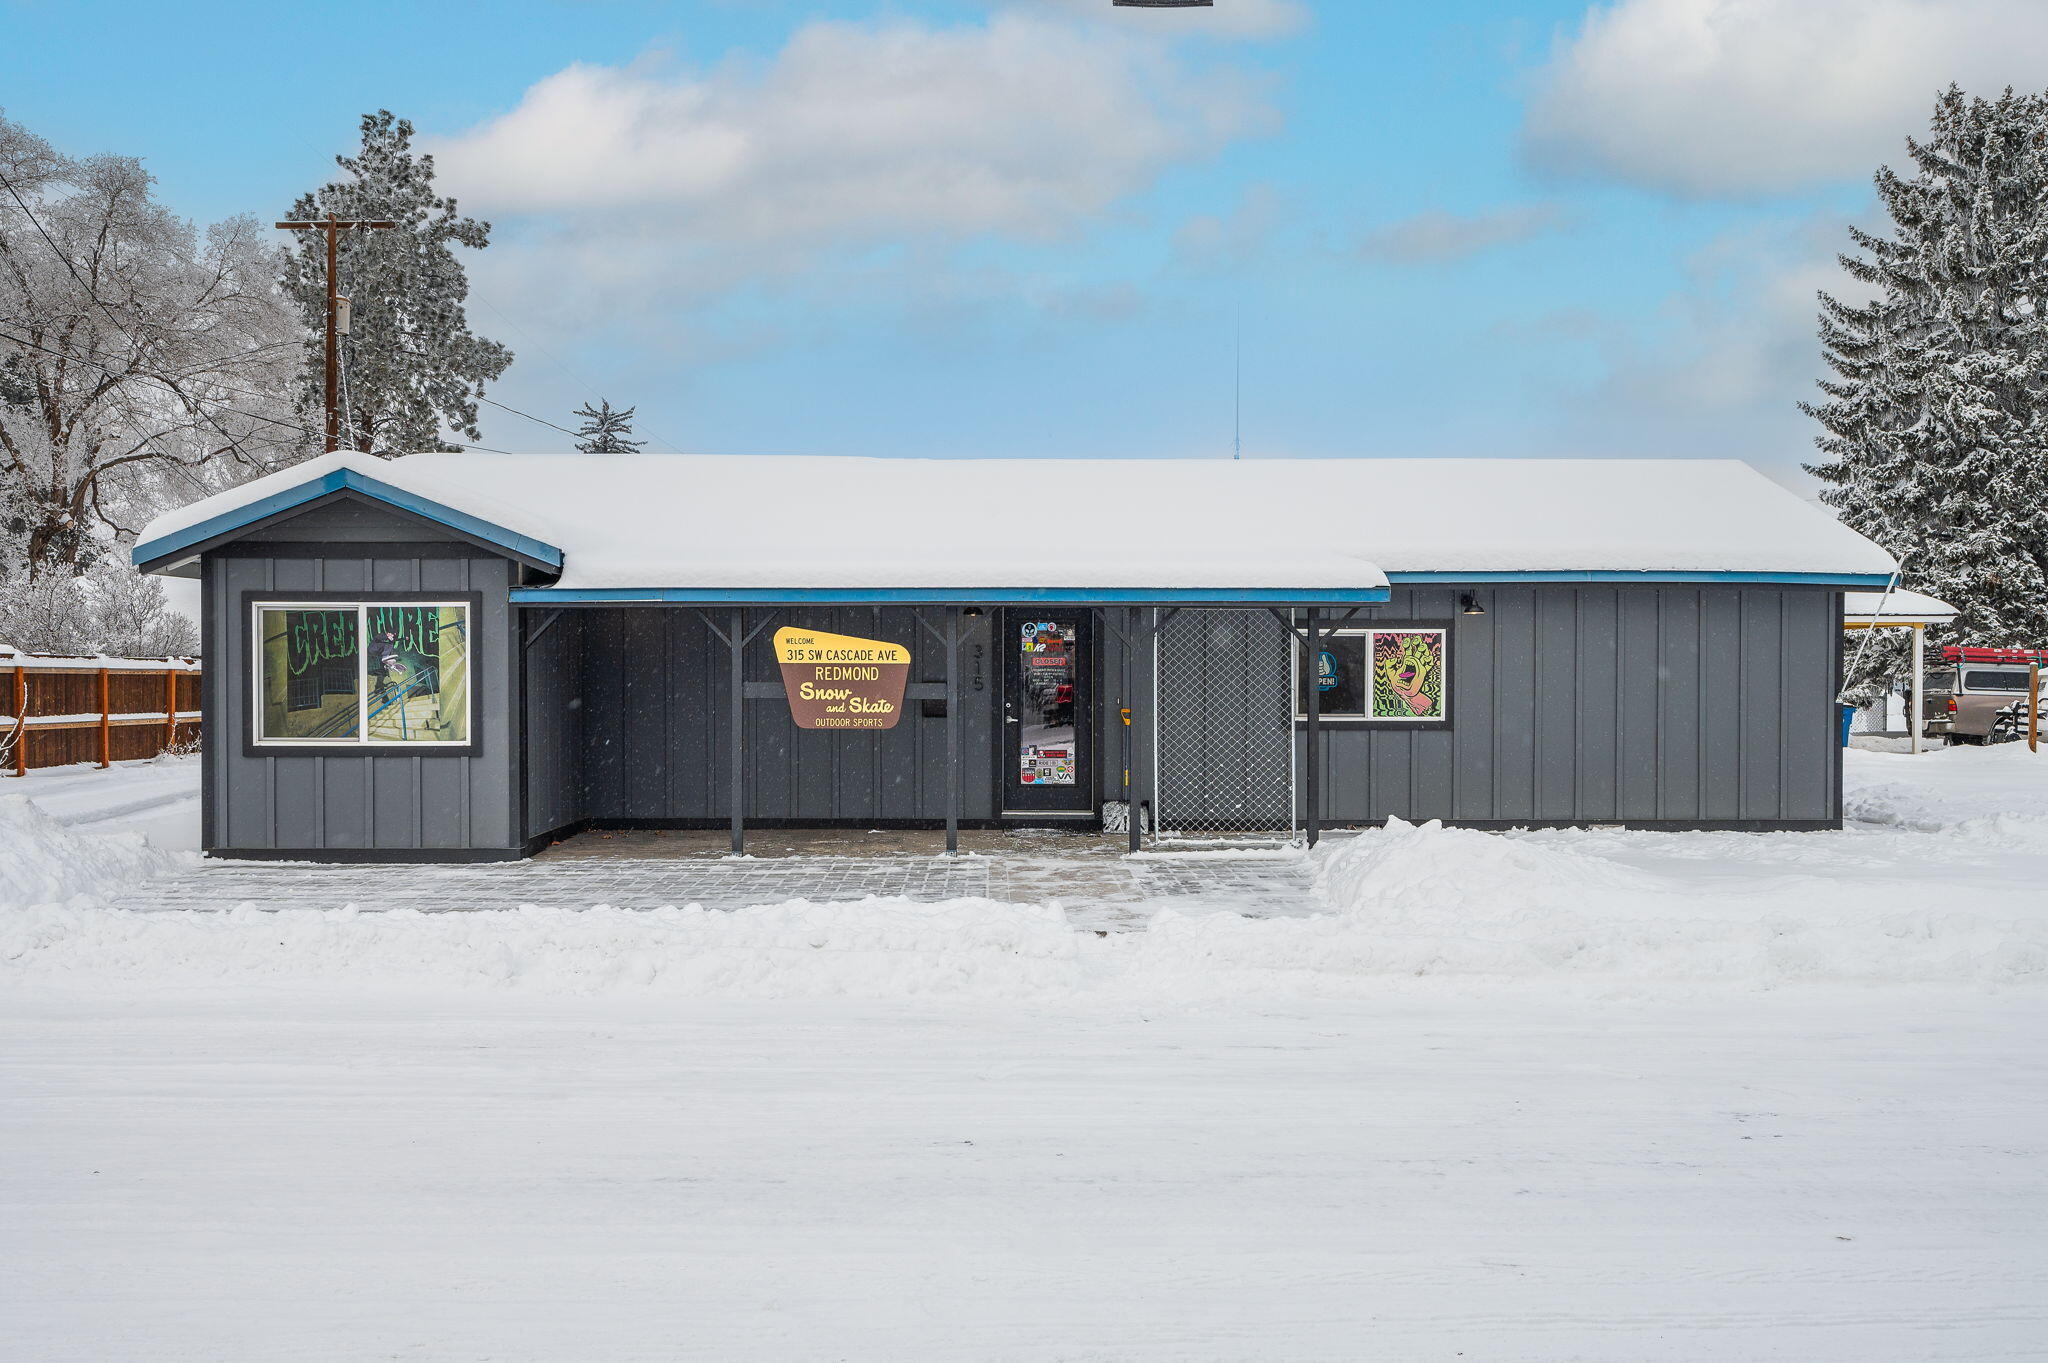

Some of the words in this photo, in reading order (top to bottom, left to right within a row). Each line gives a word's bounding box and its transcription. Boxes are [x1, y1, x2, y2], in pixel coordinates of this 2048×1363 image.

[785, 637, 815, 645] WELCOME
[787, 649, 804, 661] 315
[808, 649, 823, 661] SW
[826, 649, 874, 661] CASCADE
[877, 649, 898, 661] AVE
[815, 666, 879, 681] REDMOND
[1318, 677, 1335, 685] PEN!
[800, 681, 852, 700] Snow
[826, 702, 846, 713] and
[849, 697, 894, 713] Skate
[815, 718, 850, 727] OUTDOOR
[853, 718, 883, 727] SPORTS
